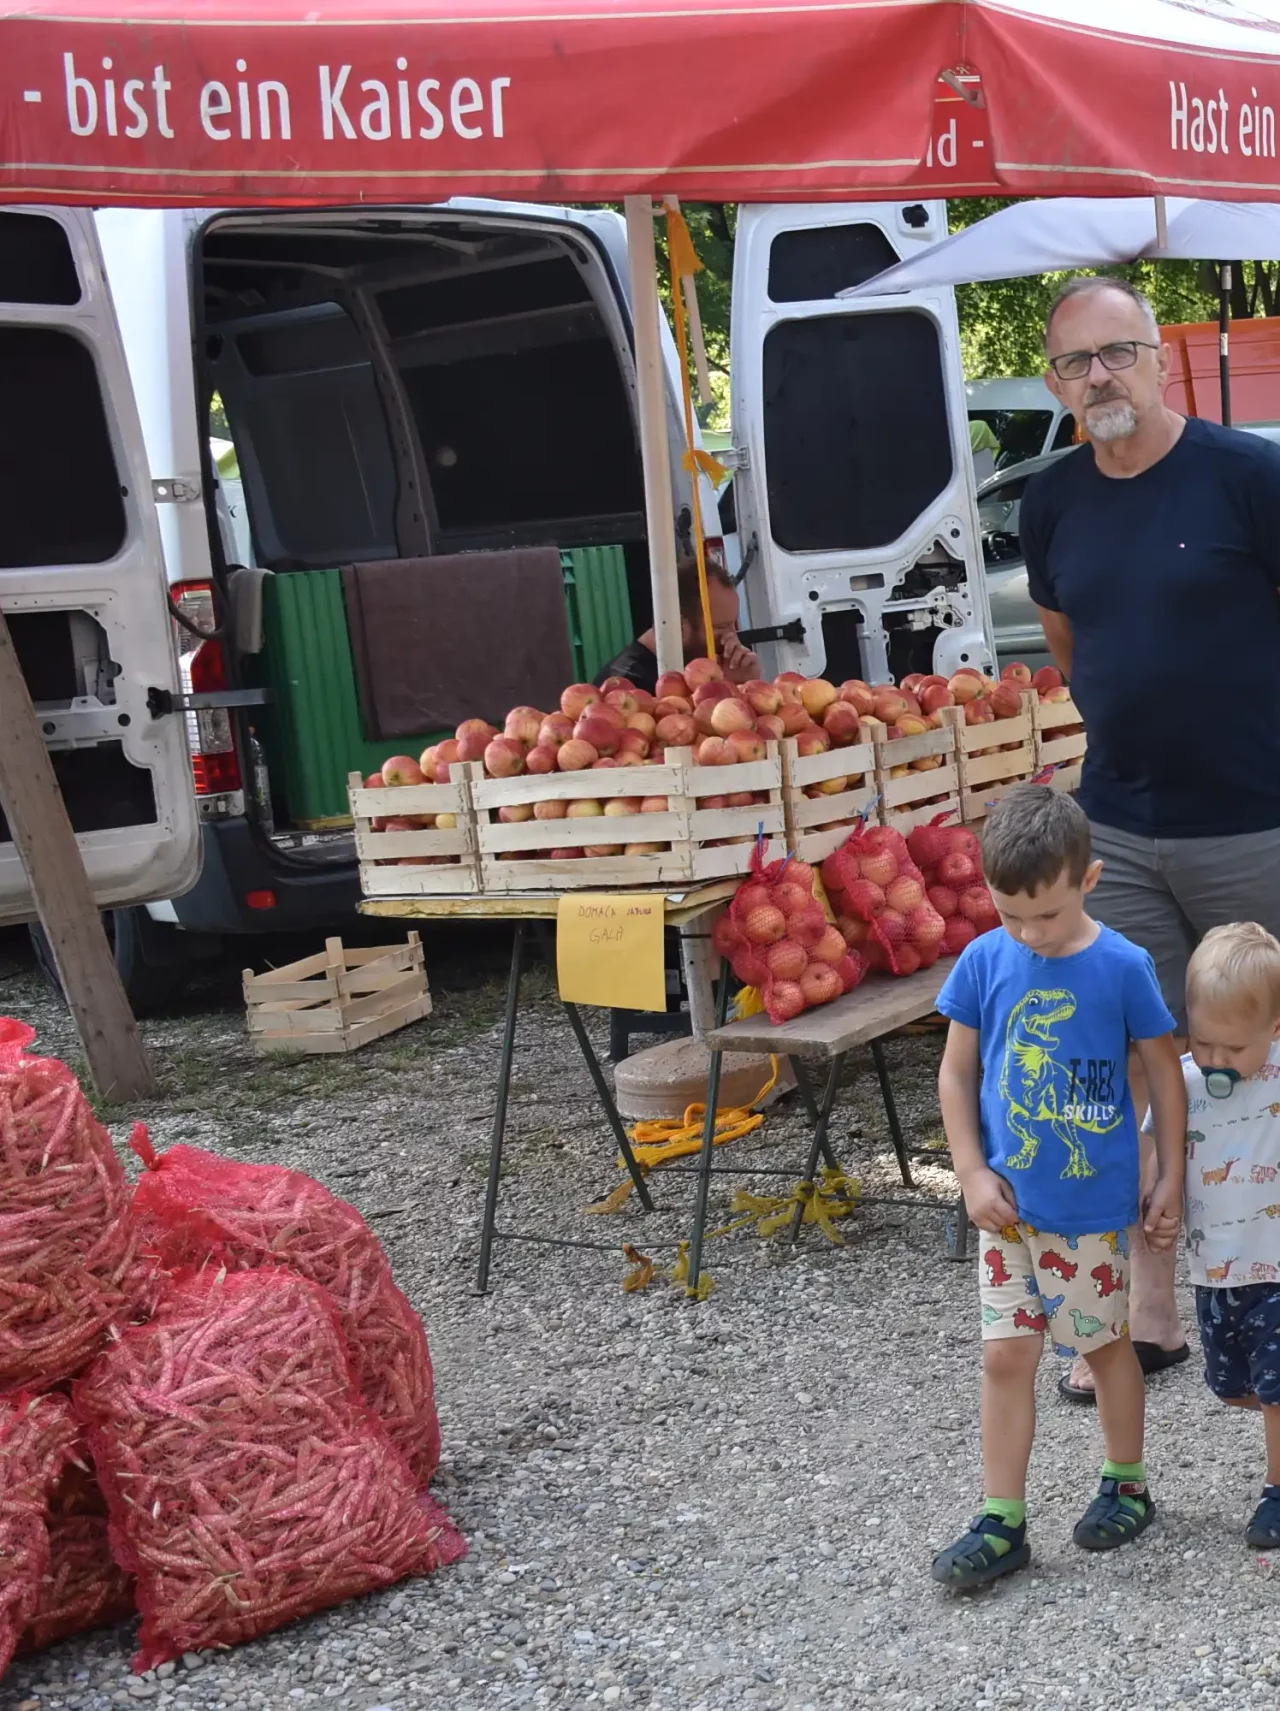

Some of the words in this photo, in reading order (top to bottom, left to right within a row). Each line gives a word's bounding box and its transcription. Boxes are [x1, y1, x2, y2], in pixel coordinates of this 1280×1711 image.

[64, 52, 174, 138] bist
[200, 59, 292, 141] ein
[319, 57, 511, 140] Kaiser
[1169, 81, 1229, 154] Hast
[1239, 86, 1275, 157] ein
[1069, 1058, 1116, 1102] T-REX
[1064, 1105, 1115, 1120] SKILLS
